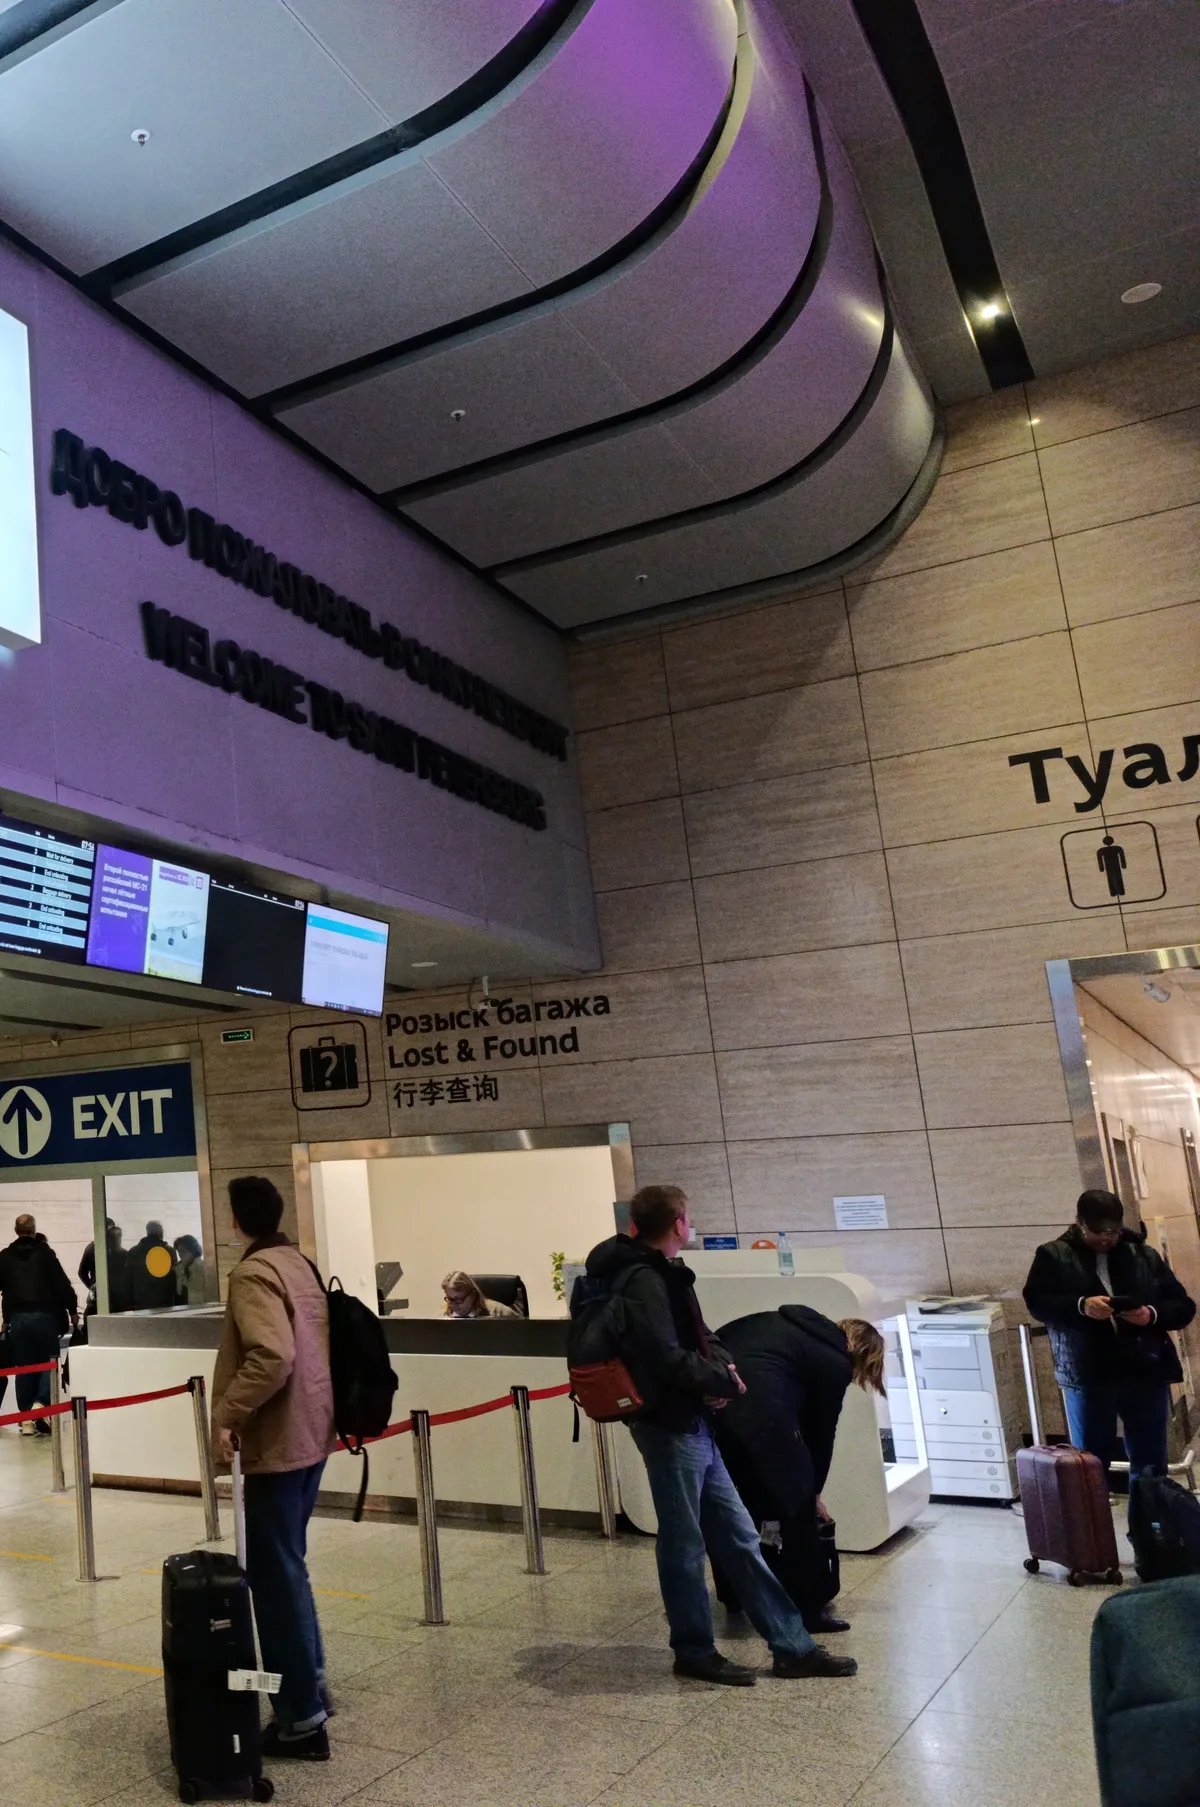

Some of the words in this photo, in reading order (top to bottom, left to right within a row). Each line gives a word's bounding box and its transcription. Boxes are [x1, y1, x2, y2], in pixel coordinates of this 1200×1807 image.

[50, 428, 188, 547] ДОБРО
[140, 601, 308, 724] WELCOME
[305, 681, 349, 740] TO
[385, 1008, 490, 1037] Розыск
[497, 994, 612, 1026] багажа
[388, 1041, 449, 1069] Lost
[456, 1039, 477, 1064] &
[483, 1026, 580, 1061] Found
[72, 1088, 173, 1140] EXIT
[393, 1074, 500, 1109] 行李查询
